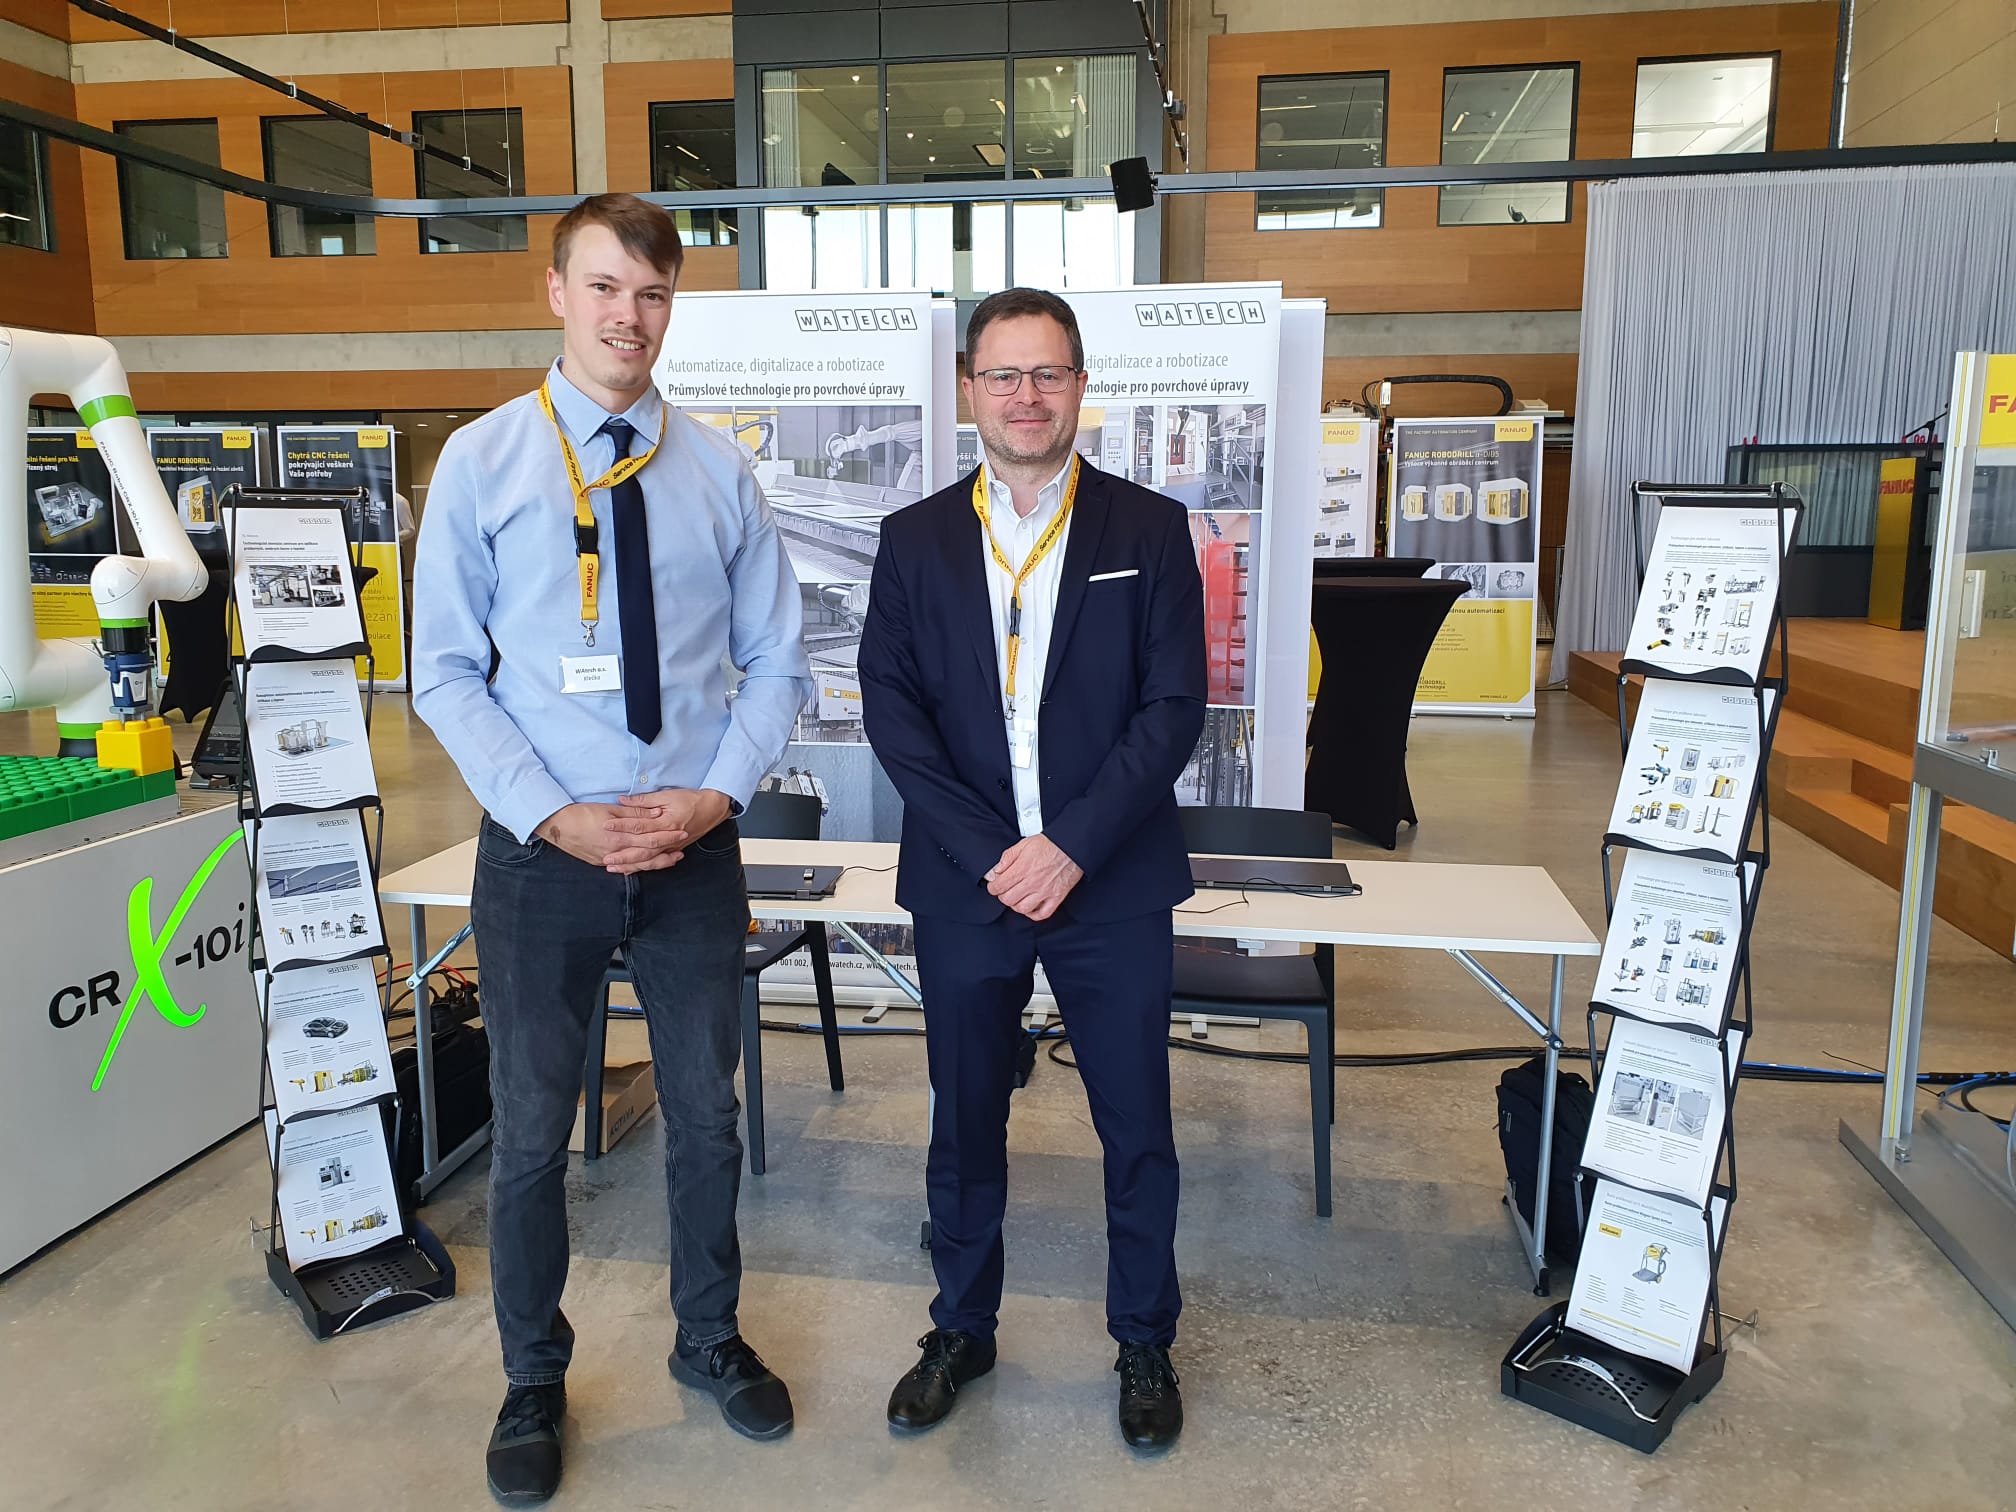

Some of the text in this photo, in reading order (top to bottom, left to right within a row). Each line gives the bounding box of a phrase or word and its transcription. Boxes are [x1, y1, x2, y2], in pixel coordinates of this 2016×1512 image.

[798, 311, 915, 328] WATECH
[1137, 304, 1262, 323] WATECH
[667, 357, 885, 375] Automatizace, digitalizace a robotizace
[1085, 353, 1229, 373] digitalizace a robotizace
[730, 383, 791, 398] technologie
[793, 386, 810, 399] pro
[813, 383, 867, 399] povrchové
[869, 382, 905, 398] úpravy
[1084, 377, 1249, 396] nologie pro povrchové úpravy
[287, 452, 311, 460] Chytrá
[327, 451, 350, 459] řešení
[1404, 451, 1430, 459] FANUC
[1431, 450, 1474, 459] ROBODRILL
[288, 460, 354, 470] pokrývající veškeré
[612, 461, 633, 479] Service
[288, 469, 333, 479] Vaše potřeby
[1880, 479, 1914, 494] FANUC
[1018, 516, 1064, 581] FANUC Service First
[586, 562, 594, 598] FANUC
[365, 608, 397, 622] ezání
[780, 959, 792, 968] 001
[794, 959, 809, 969] 002,
[610, 1105, 635, 1137] ACTIVA
